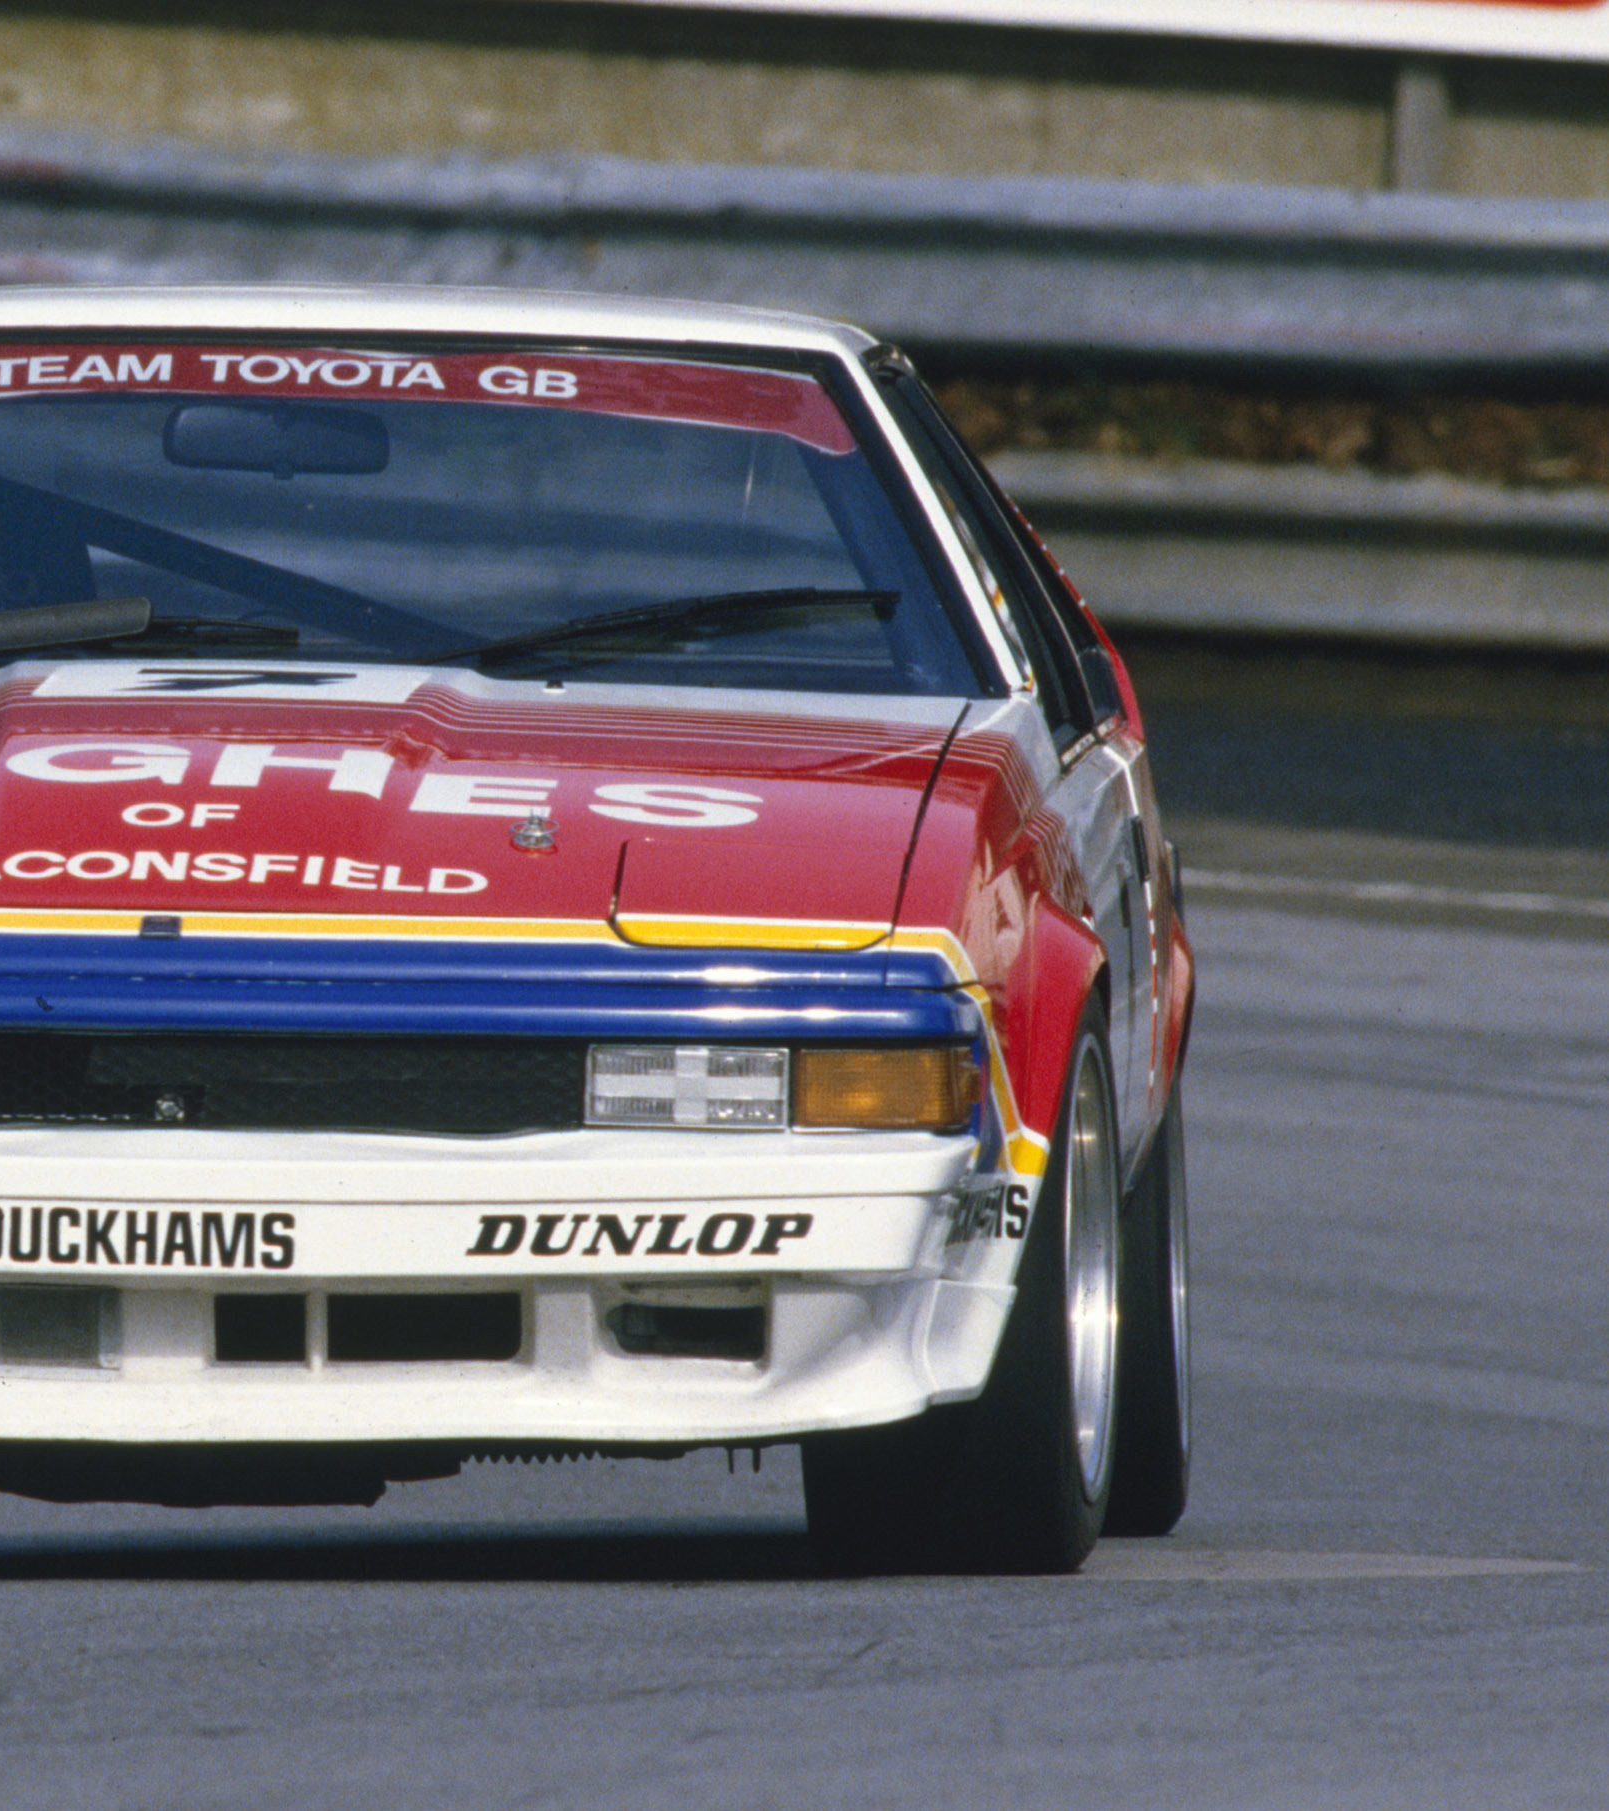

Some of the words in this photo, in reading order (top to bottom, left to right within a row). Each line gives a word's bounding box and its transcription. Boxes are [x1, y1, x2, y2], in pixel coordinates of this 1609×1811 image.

[200, 354, 445, 390] TOYOTA
[478, 365, 578, 398] GB
[121, 803, 241, 827] OF
[465, 1213, 814, 1257] DUNLOP
